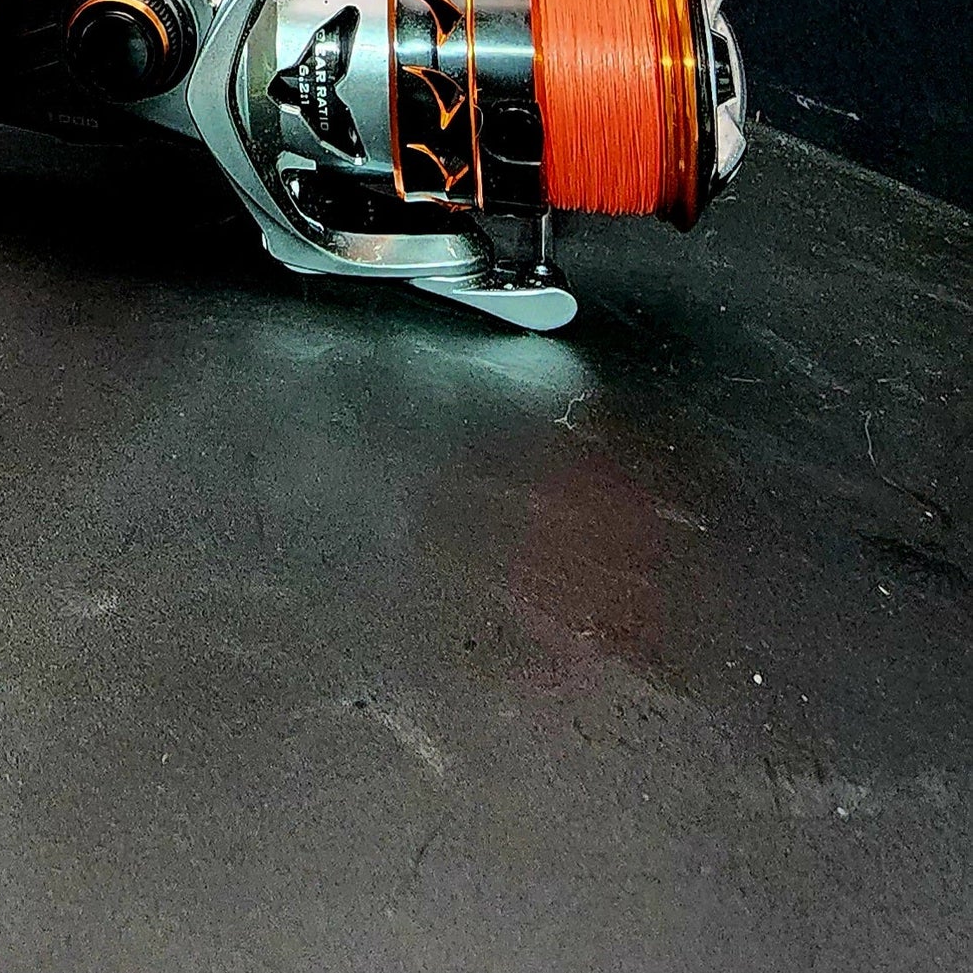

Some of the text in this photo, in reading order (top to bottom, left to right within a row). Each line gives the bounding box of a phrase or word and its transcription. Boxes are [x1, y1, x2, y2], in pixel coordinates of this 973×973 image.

[298, 64, 310, 105] 6.2:1
[315, 29, 330, 131] GEAR RATIO
